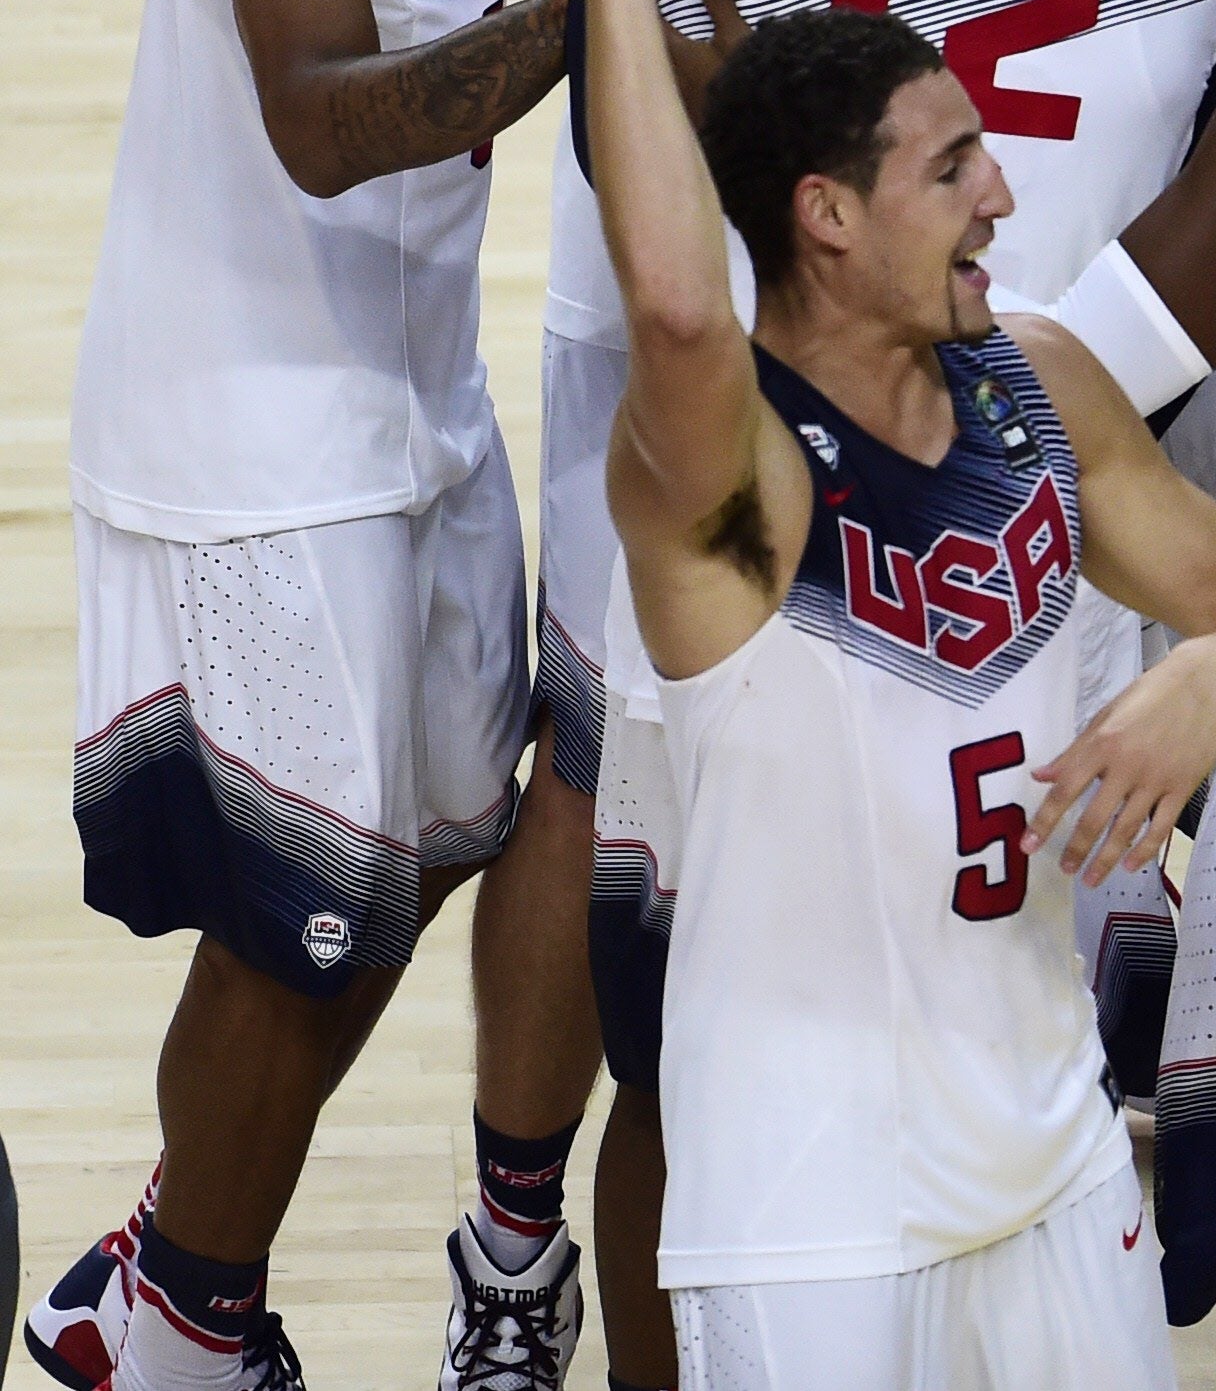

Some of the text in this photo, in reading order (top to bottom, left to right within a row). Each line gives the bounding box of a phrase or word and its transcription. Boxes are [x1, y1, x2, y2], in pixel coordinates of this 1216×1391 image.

[837, 469, 1076, 675] USA
[949, 730, 1030, 922] 5
[314, 920, 342, 937] USA
[488, 1158, 562, 1190] USA
